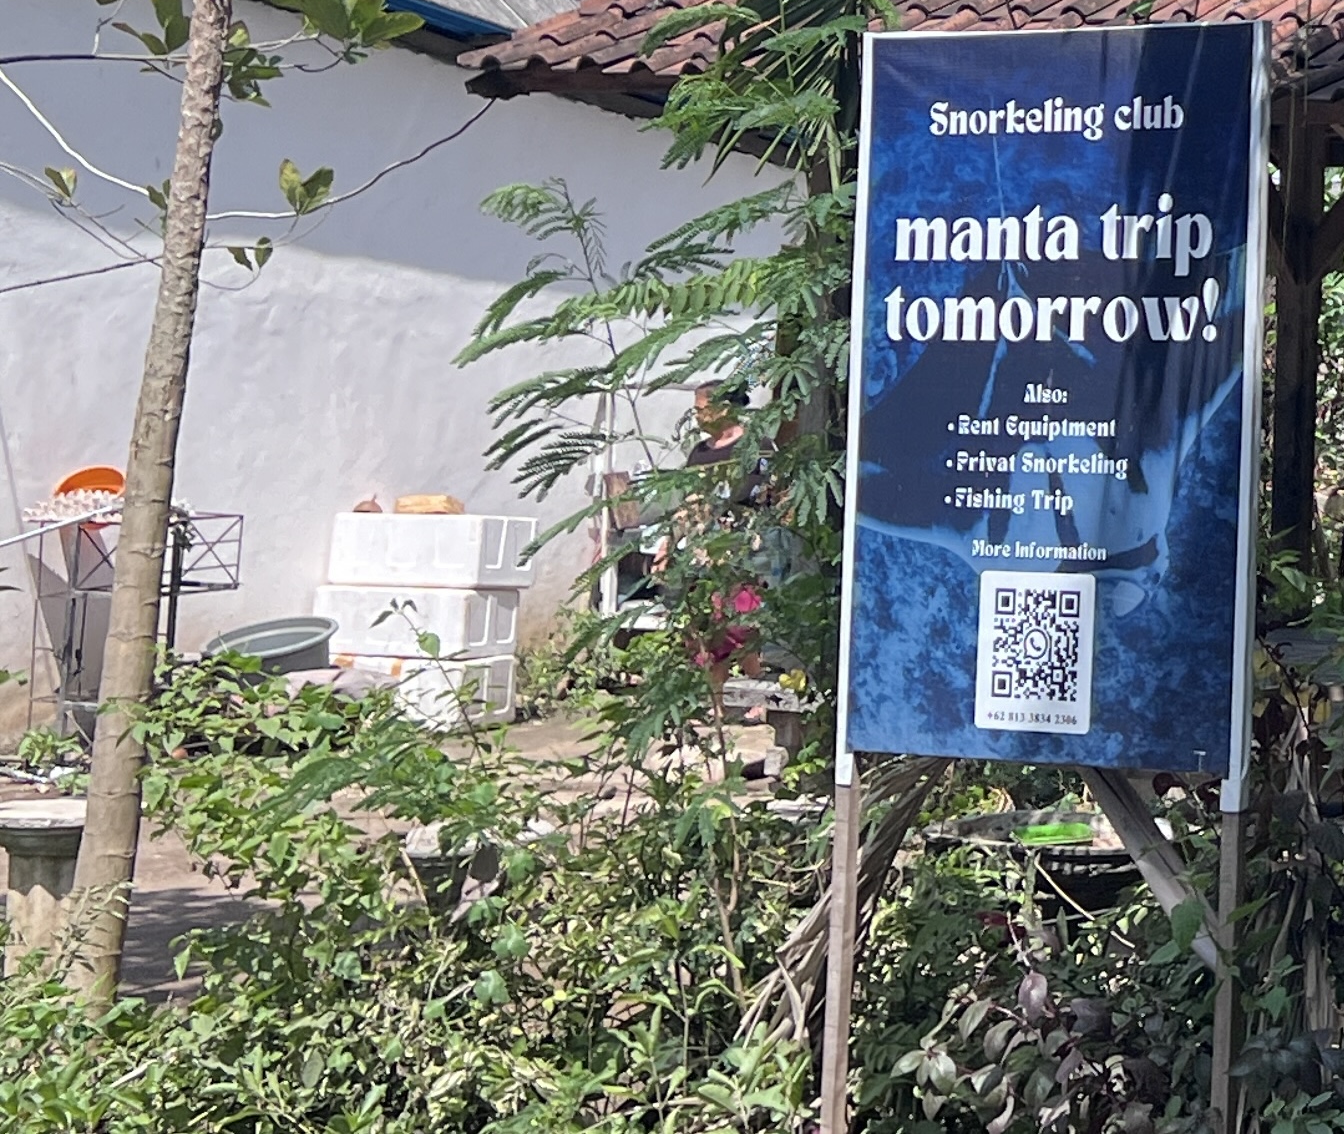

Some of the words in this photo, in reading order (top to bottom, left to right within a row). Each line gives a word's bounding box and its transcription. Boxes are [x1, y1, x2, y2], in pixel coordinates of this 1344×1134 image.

[929, 97, 1104, 141] Snorkeling
[1114, 96, 1185, 130] club
[895, 205, 1080, 261] manta
[1101, 193, 1214, 277] trip
[884, 278, 1220, 343] tomorrow!
[1023, 384, 1068, 404] Also:
[958, 415, 999, 436] Rent
[1006, 415, 1116, 441] Equiptment
[956, 451, 1015, 472] Privat
[1021, 452, 1128, 480] Snorkeling
[955, 487, 1025, 514] Fishing
[1032, 489, 1074, 515] Trip
[972, 540, 1010, 558] More
[1015, 541, 1107, 561] Information
